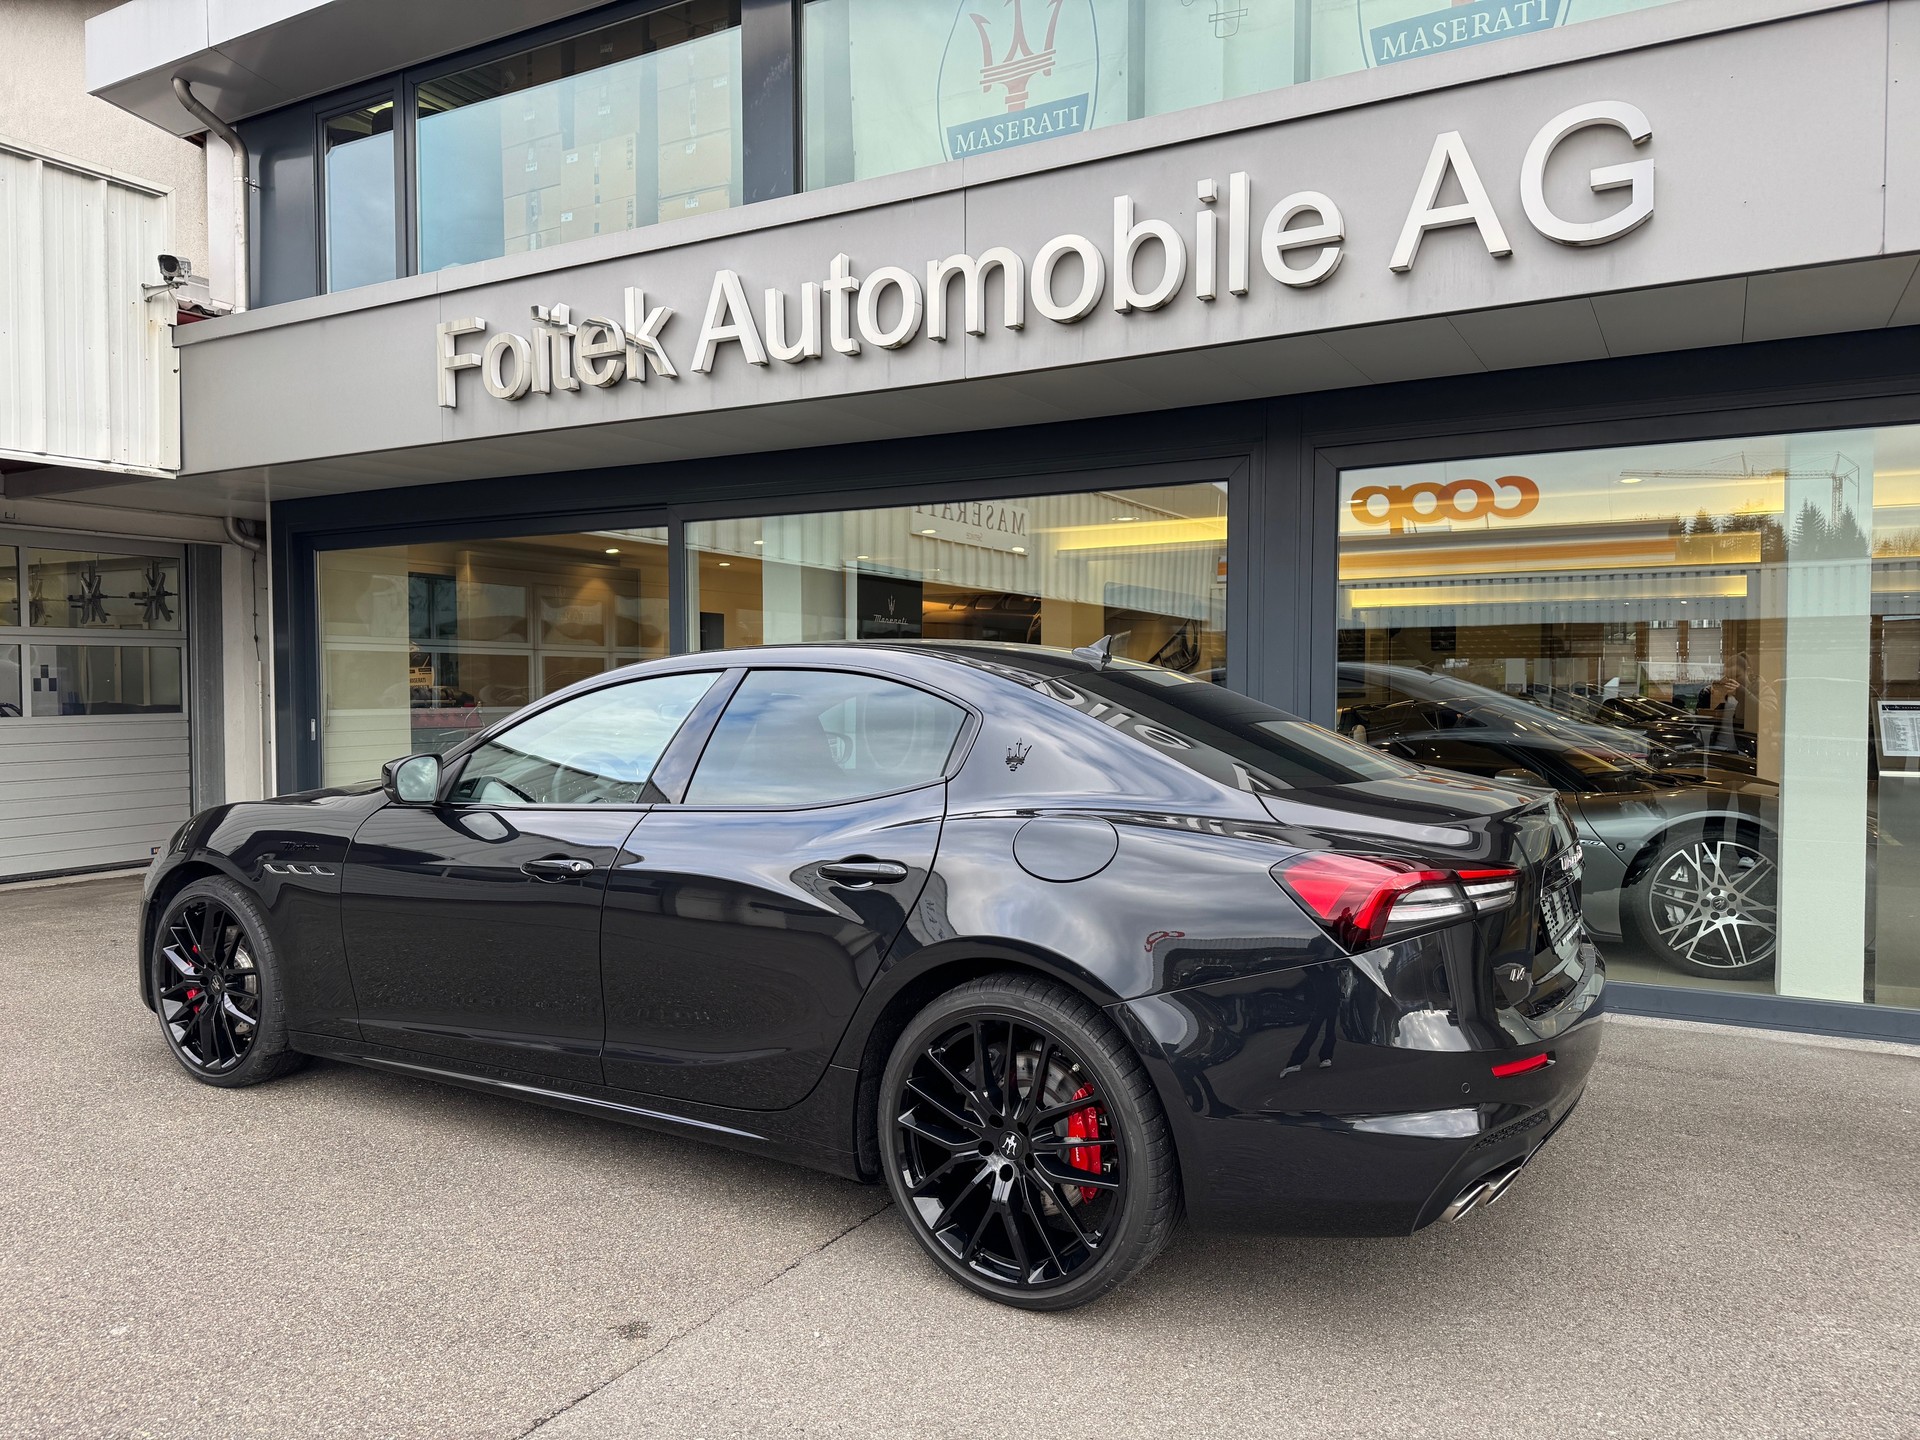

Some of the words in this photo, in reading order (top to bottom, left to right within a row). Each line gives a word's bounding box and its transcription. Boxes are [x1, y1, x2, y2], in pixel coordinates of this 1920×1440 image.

[1380, 0, 1550, 61] MASERATI
[954, 105, 1080, 154] MASERATI
[436, 286, 679, 409] Foitek
[690, 171, 1346, 374] Automobile
[1388, 100, 1655, 274] AG
